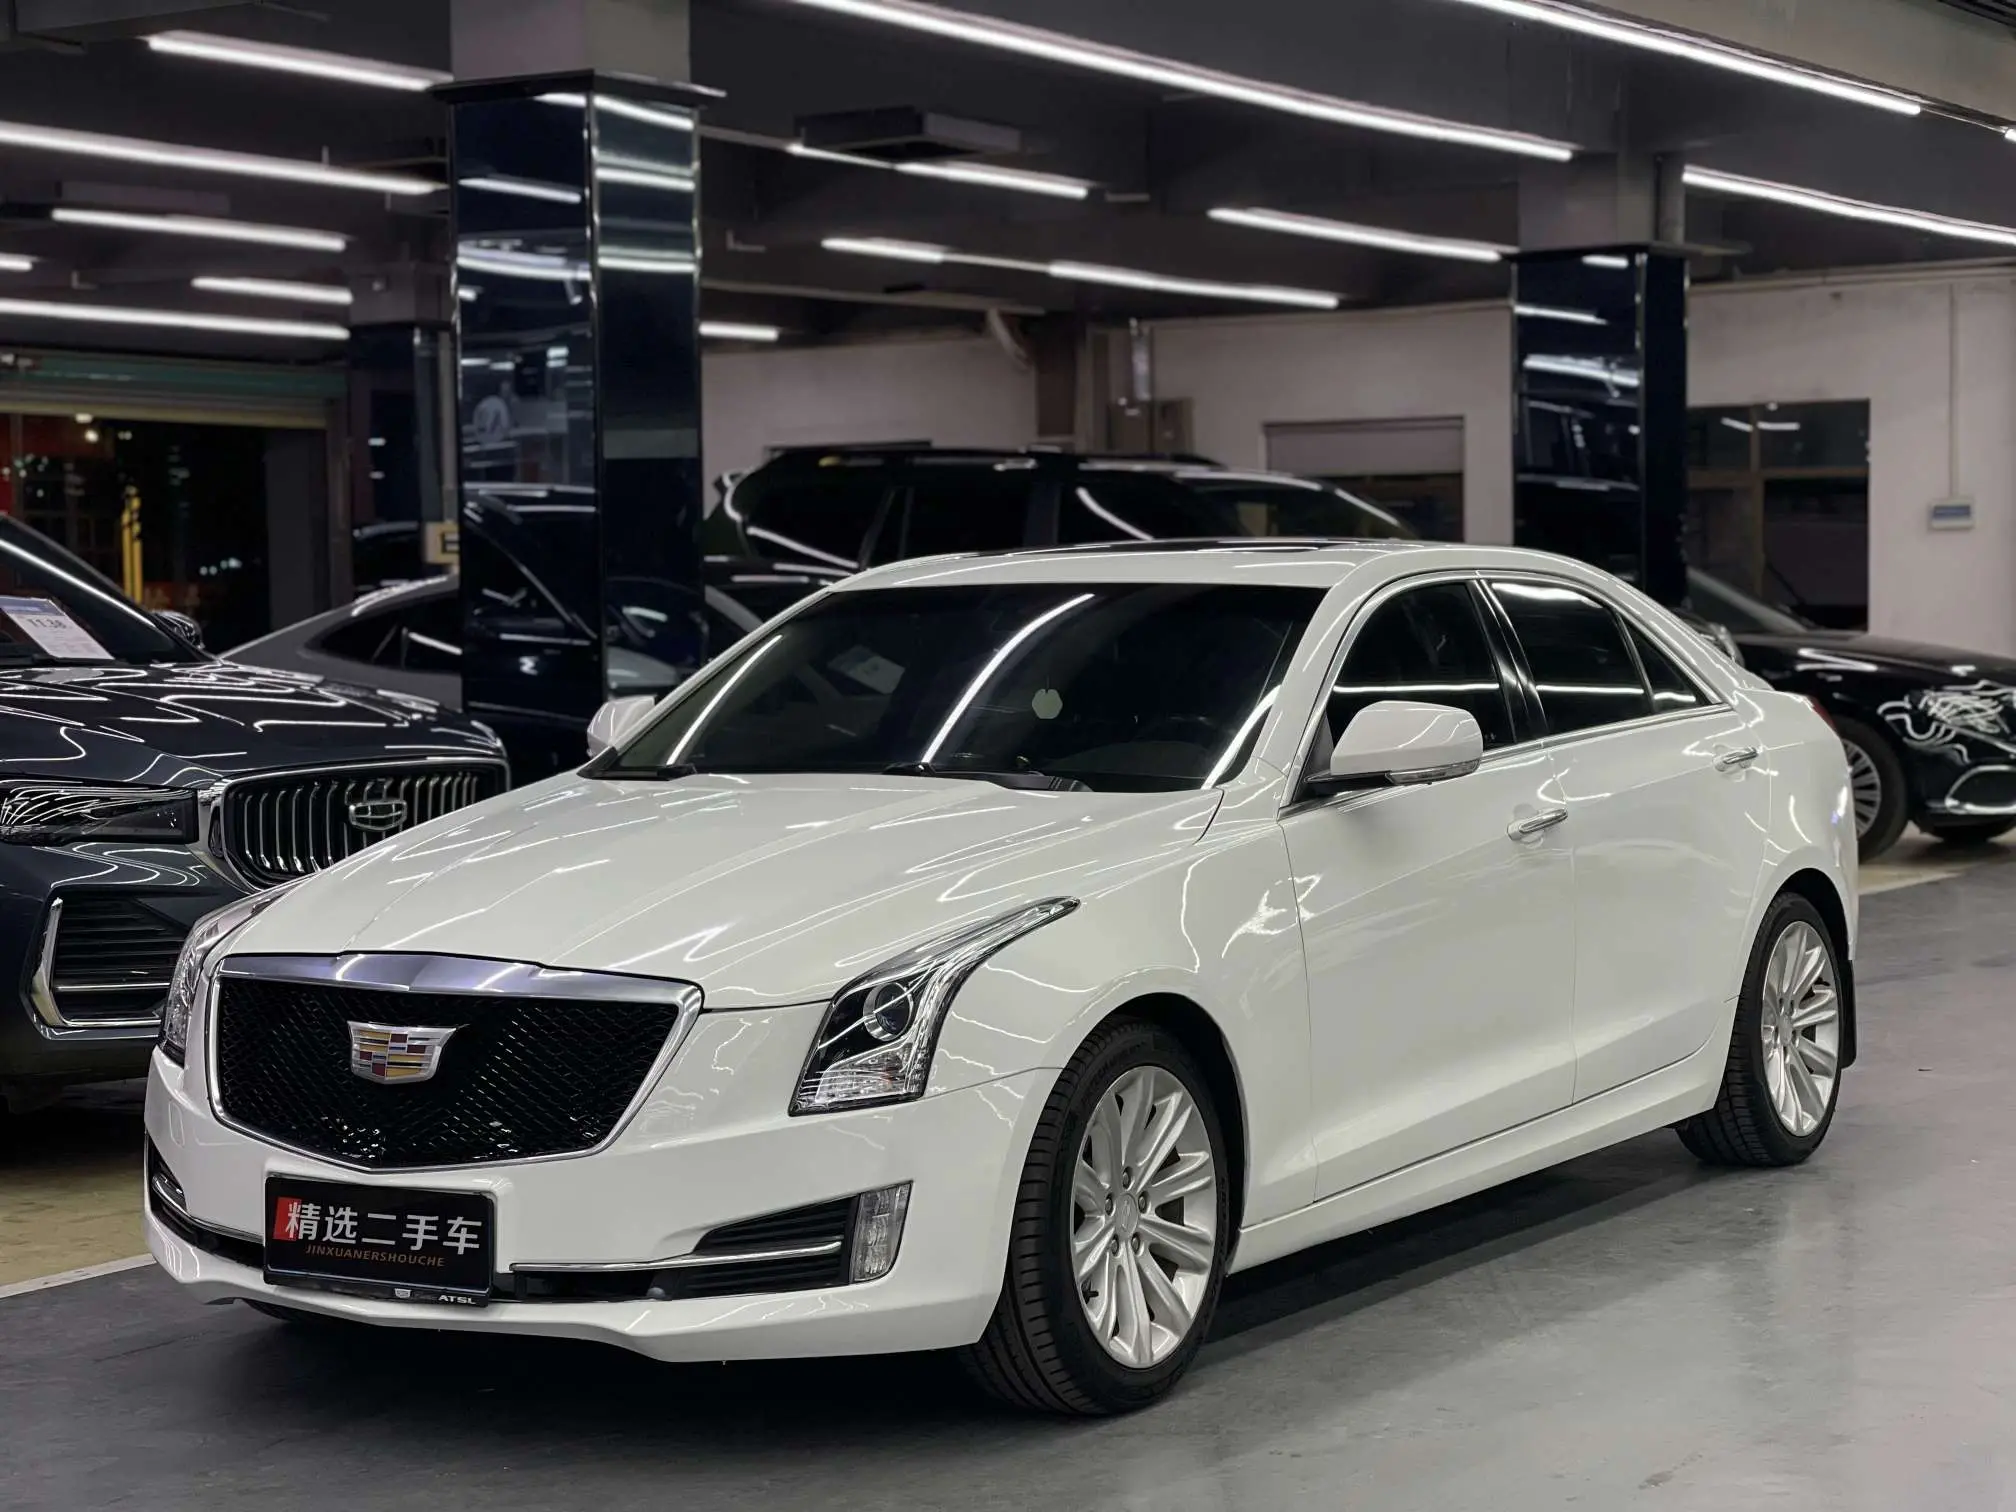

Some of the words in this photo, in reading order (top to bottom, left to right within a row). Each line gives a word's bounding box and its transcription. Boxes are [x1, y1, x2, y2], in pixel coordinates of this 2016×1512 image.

[286, 1202, 482, 1254] 精选二手车
[305, 1245, 445, 1267] JINXUANERSHOUCHE
[438, 1294, 476, 1305] ATSL
